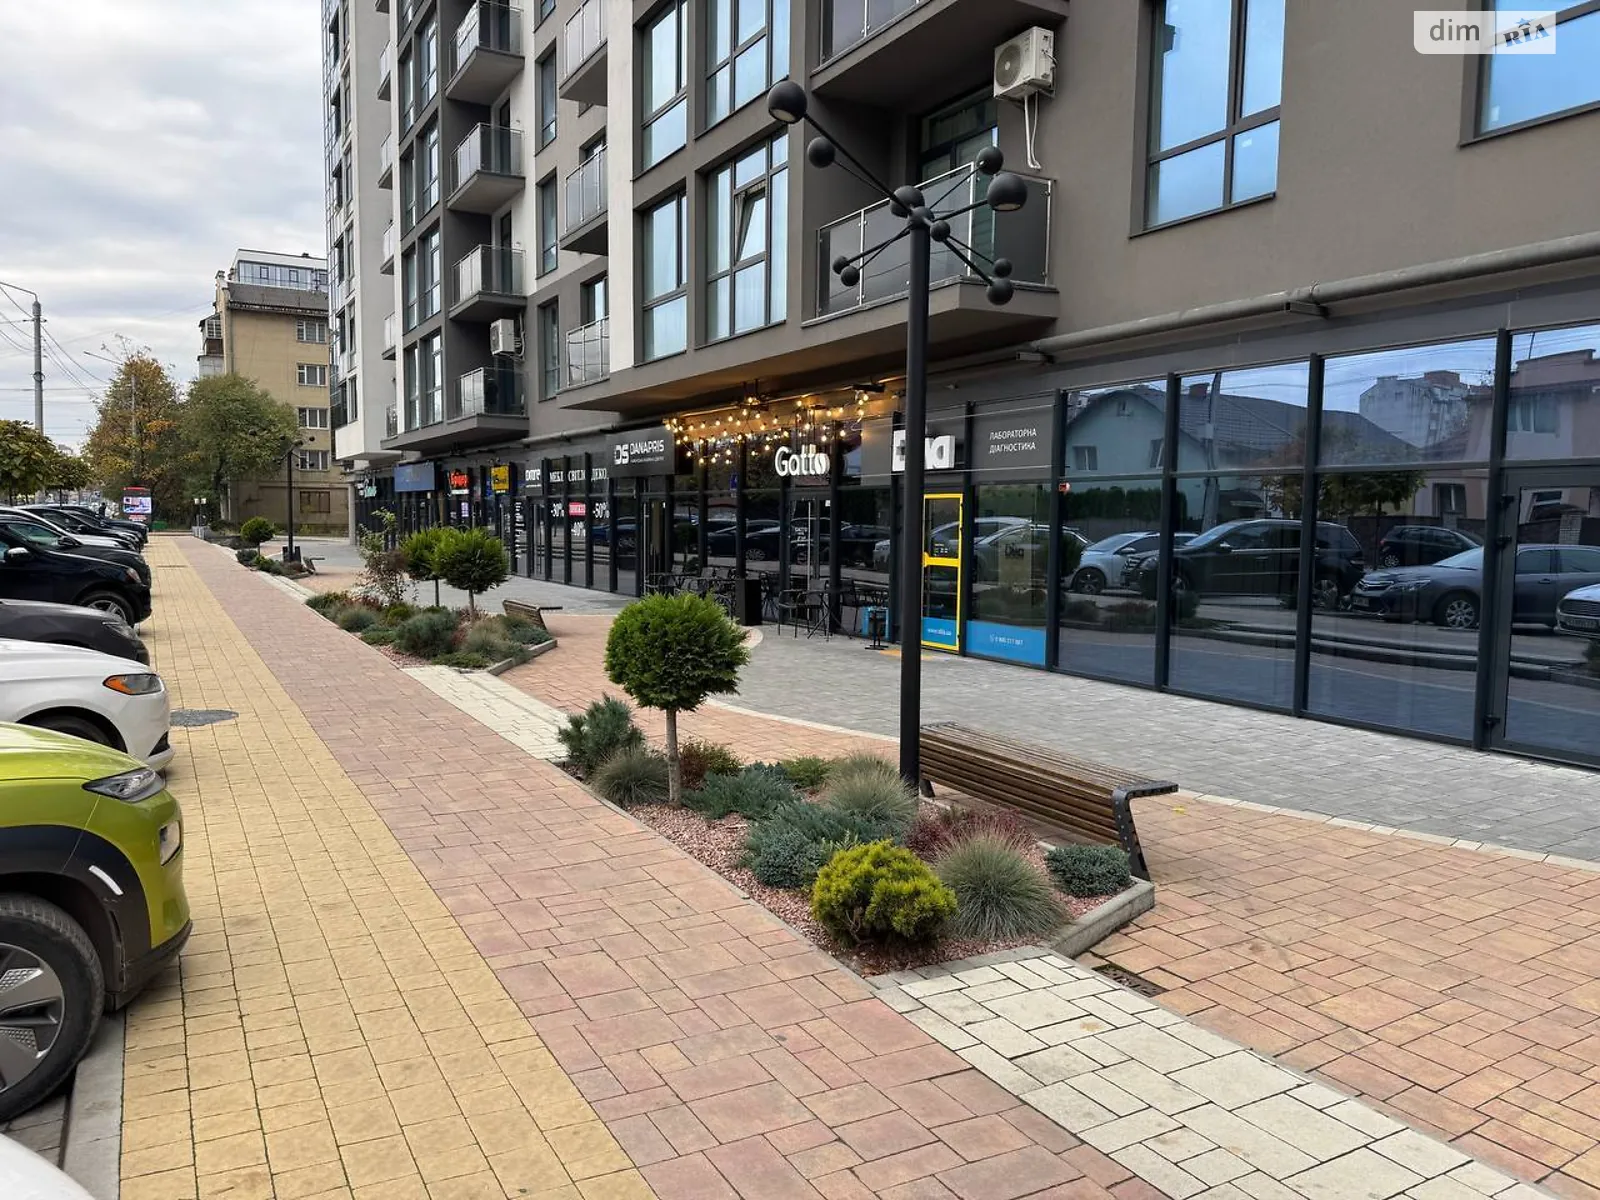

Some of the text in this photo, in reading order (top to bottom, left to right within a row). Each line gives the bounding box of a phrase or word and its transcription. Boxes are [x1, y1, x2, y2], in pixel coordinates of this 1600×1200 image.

[989, 428, 1037, 440] ЛАБОРАТОРНА
[630, 439, 665, 455] DANAPRIS
[989, 442, 1036, 454] ДІАГНОСТИКА
[774, 443, 831, 477] Gatto
